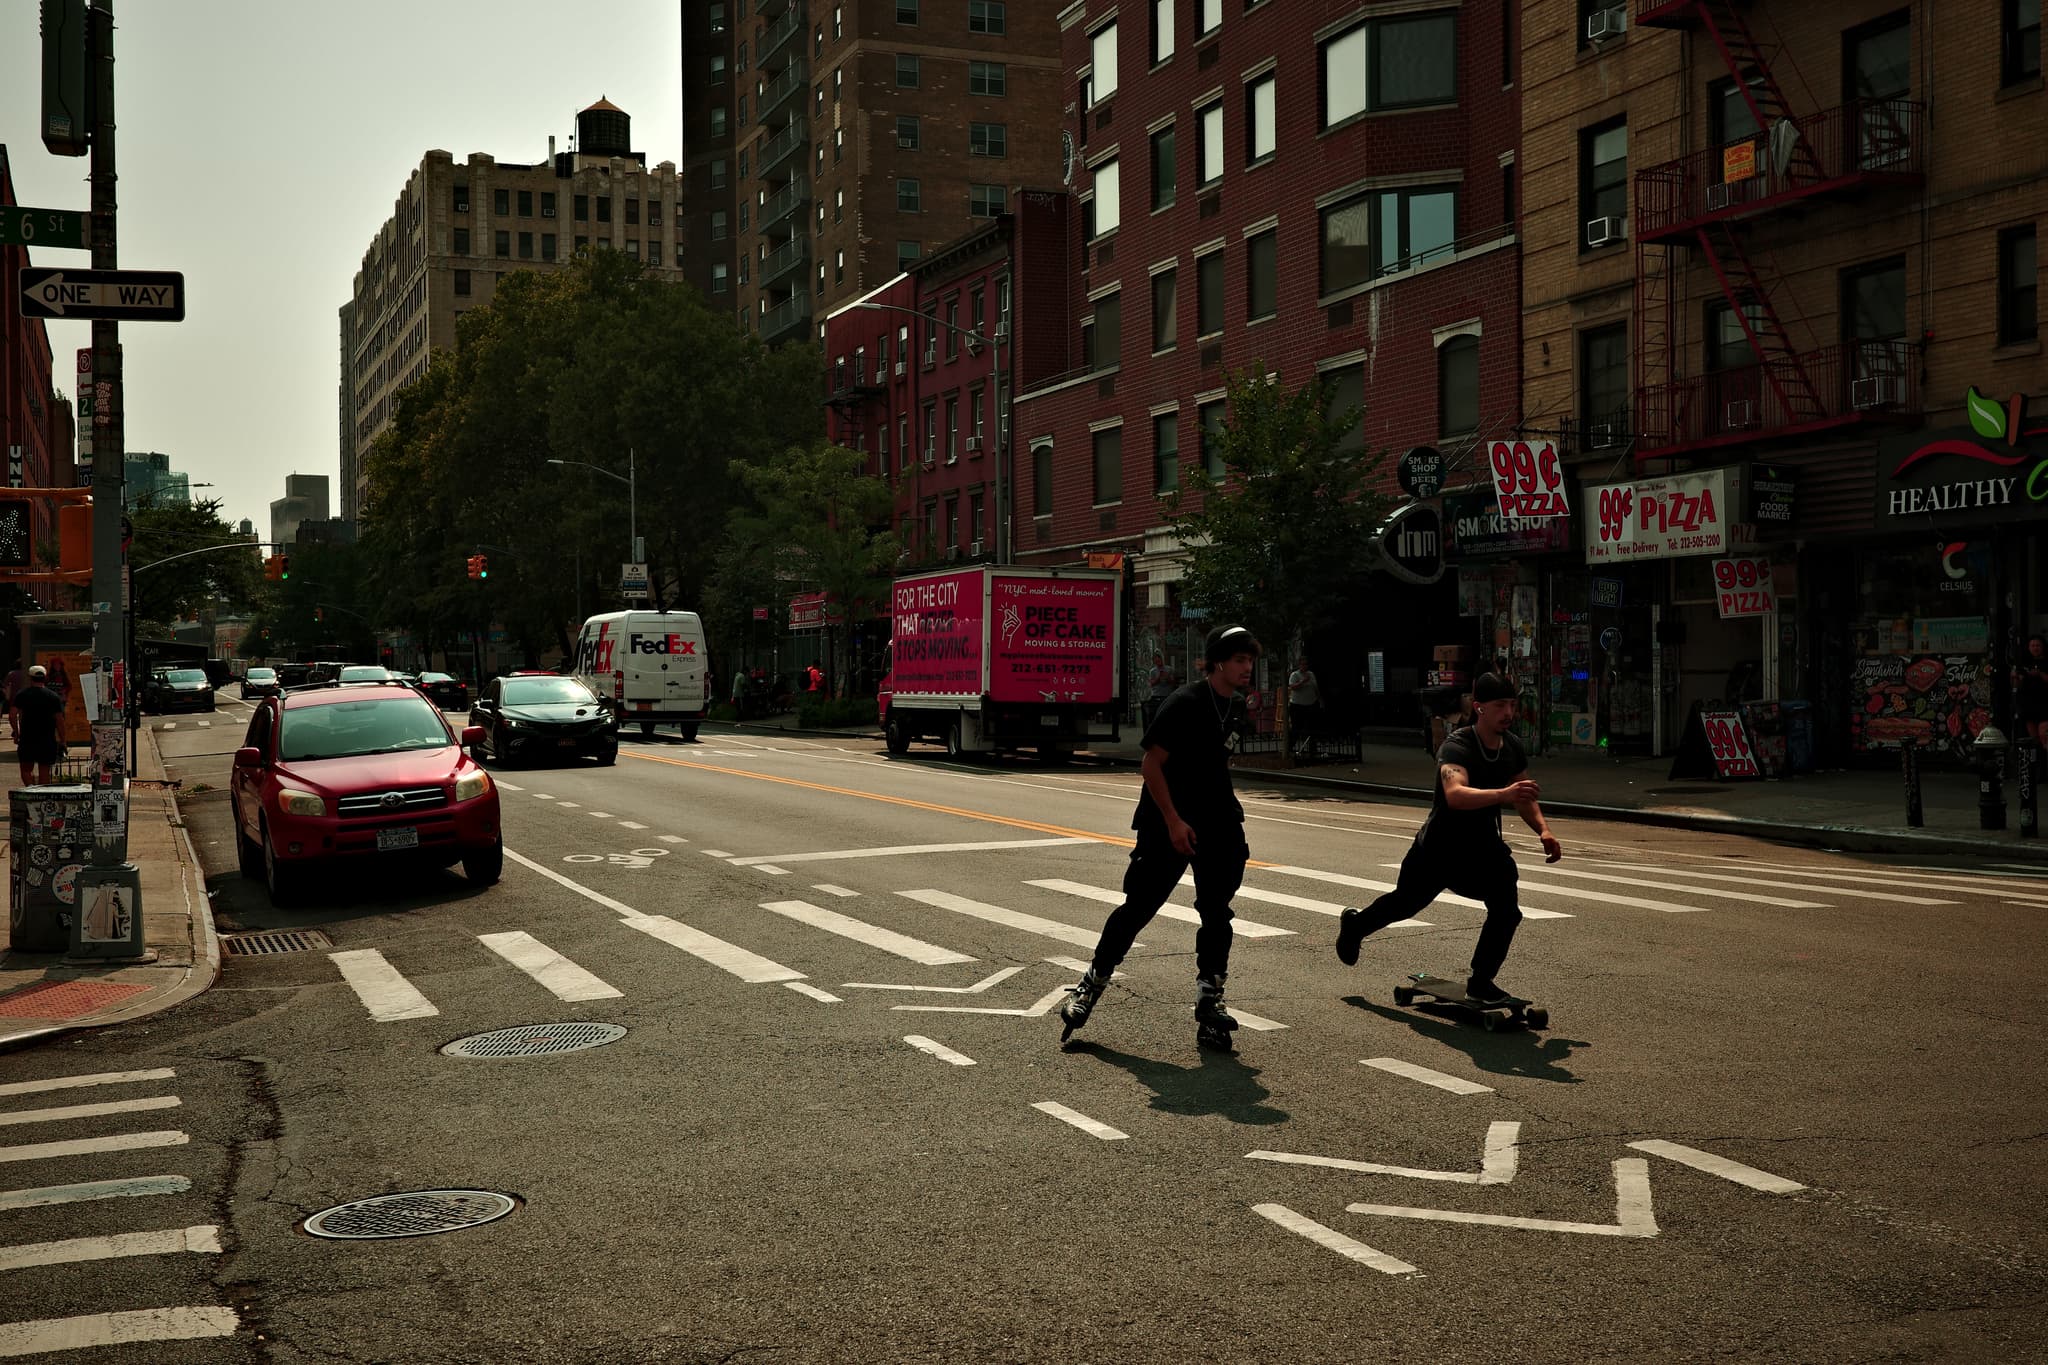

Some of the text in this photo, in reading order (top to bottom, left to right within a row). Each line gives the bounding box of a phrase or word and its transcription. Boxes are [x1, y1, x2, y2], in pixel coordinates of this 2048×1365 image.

[20, 212, 35, 241] 6
[47, 215, 65, 233] St
[43, 285, 168, 306] ONE WAY
[1410, 464, 1437, 473] SHOP
[1492, 442, 1561, 494] 99¢
[1410, 476, 1438, 485] BEER
[1499, 493, 1570, 517] PIZZA
[1760, 502, 1789, 512] FOODS
[1887, 477, 2017, 516] HEALTHY
[1599, 487, 1633, 542] 99¢
[1757, 510, 1792, 521] MARKET
[1397, 520, 1437, 558] drom
[1617, 543, 1631, 555] Free
[1632, 541, 1659, 554] Delivery
[1680, 533, 1721, 549] 212-505-1200
[1715, 559, 1770, 589] 99¢
[896, 581, 960, 610] FOR THE CITY
[1939, 581, 1974, 592] CELSIUS
[1721, 591, 1772, 614] PIZZA
[896, 612, 920, 636] THAT
[1025, 606, 1078, 622] PIECE
[1025, 623, 1107, 639] OF CAKE
[630, 633, 696, 655] FedEx
[897, 639, 927, 661] STOPS
[1024, 640, 1107, 649] MOVING & STORAGE
[672, 655, 697, 663] Express
[1946, 663, 1980, 683] Salad
[1705, 719, 1749, 759] 99¢
